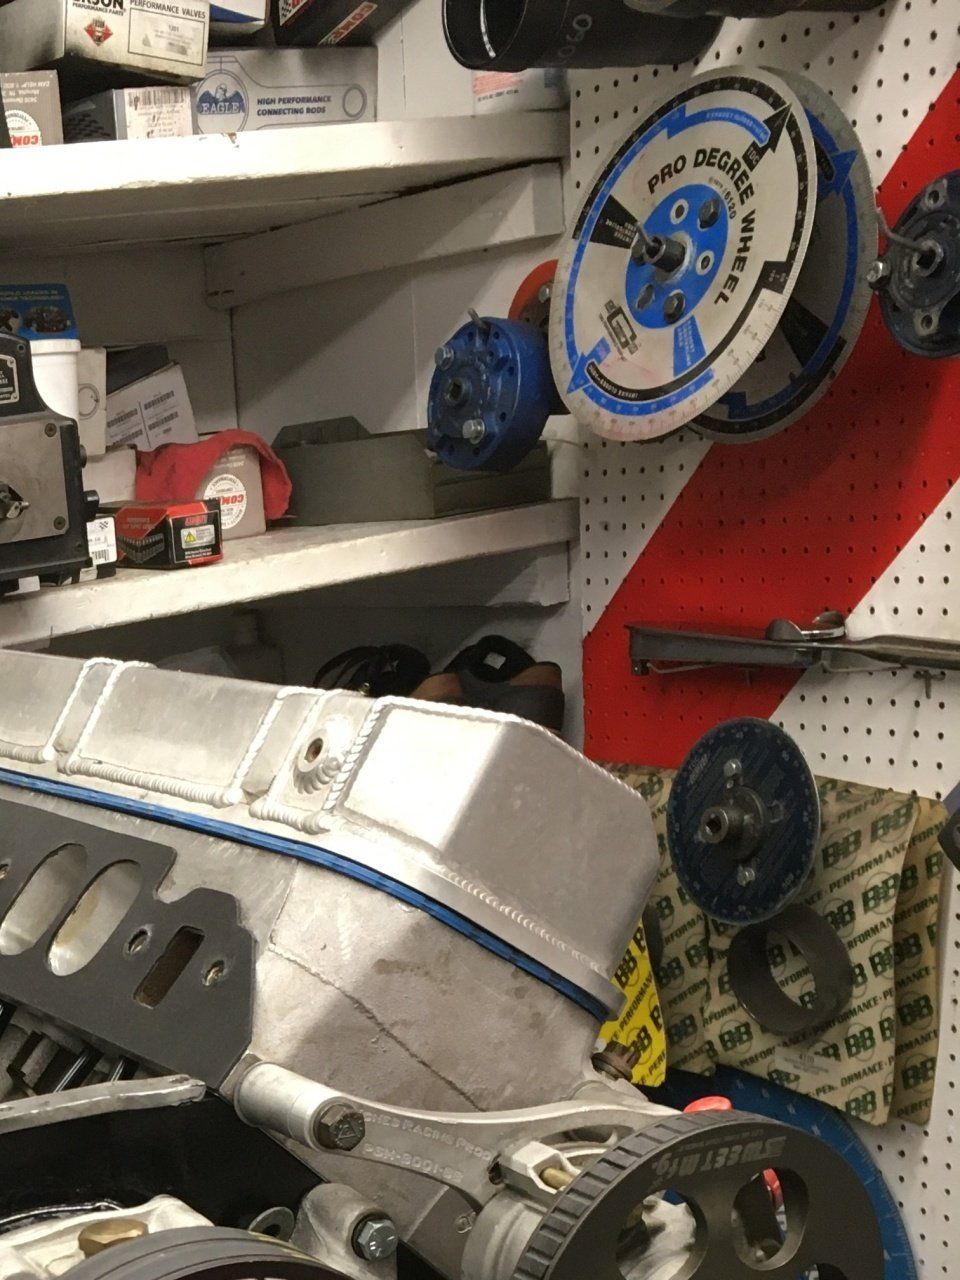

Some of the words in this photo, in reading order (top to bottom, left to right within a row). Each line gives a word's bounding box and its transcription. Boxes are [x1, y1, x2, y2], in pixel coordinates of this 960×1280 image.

[129, 0, 179, 14] PERFORMANCE
[181, 8, 206, 19] VALVES
[278, 96, 332, 105] PERFORMANCE
[201, 102, 241, 113] EAGLE
[257, 107, 305, 117] CONNECTING
[306, 106, 327, 115] RODS
[11, 134, 39, 146] COM
[647, 155, 687, 195] PRO
[693, 147, 755, 205] DEGREE
[714, 209, 756, 305] WHEEL
[220, 495, 244, 506] COM
